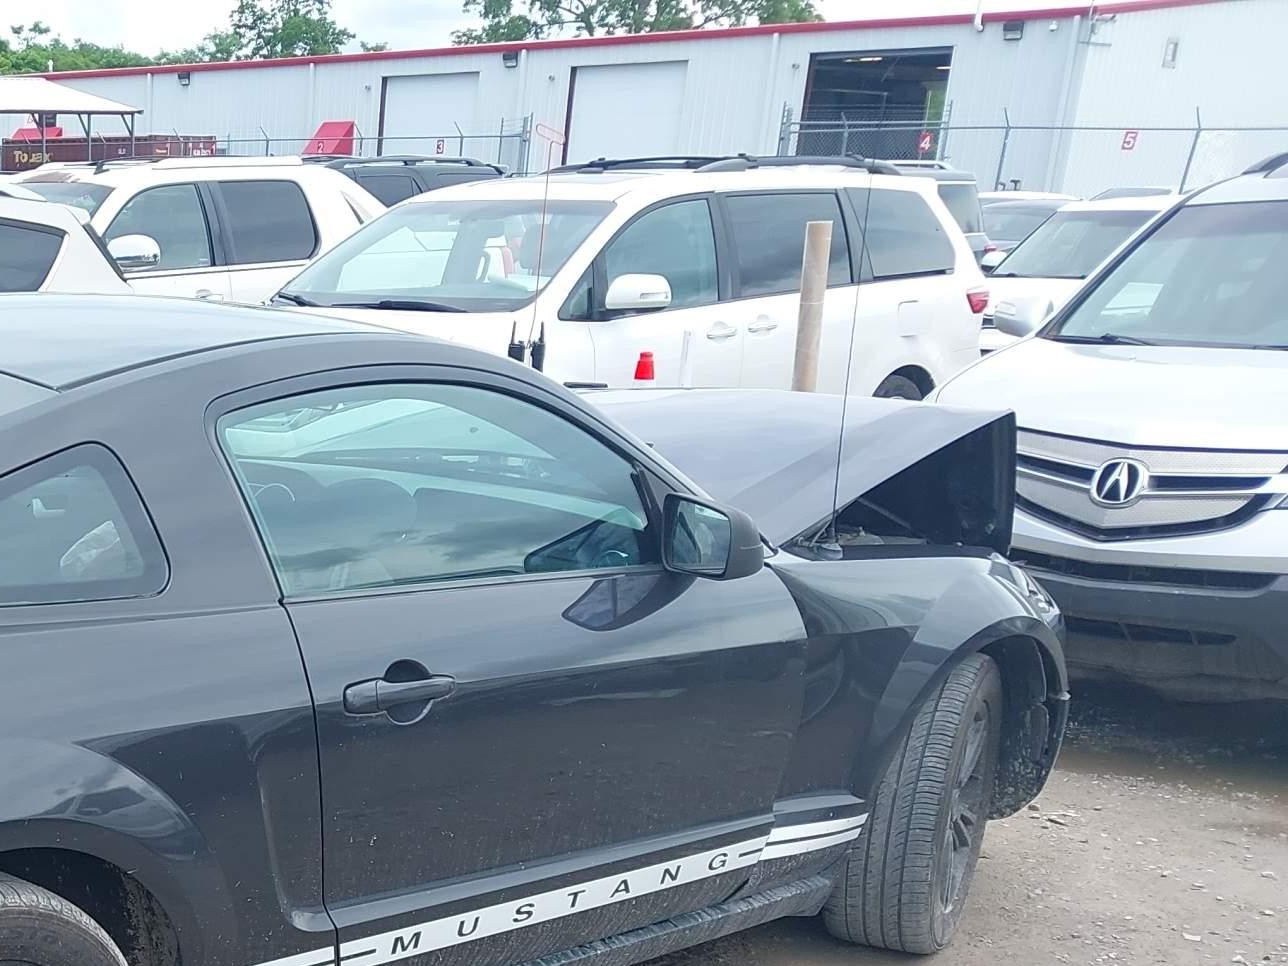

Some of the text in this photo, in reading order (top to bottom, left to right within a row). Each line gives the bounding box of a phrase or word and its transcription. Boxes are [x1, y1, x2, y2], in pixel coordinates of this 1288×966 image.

[919, 134, 931, 150] 4
[1123, 132, 1136, 149] 5
[390, 852, 729, 955] MUSTANG
